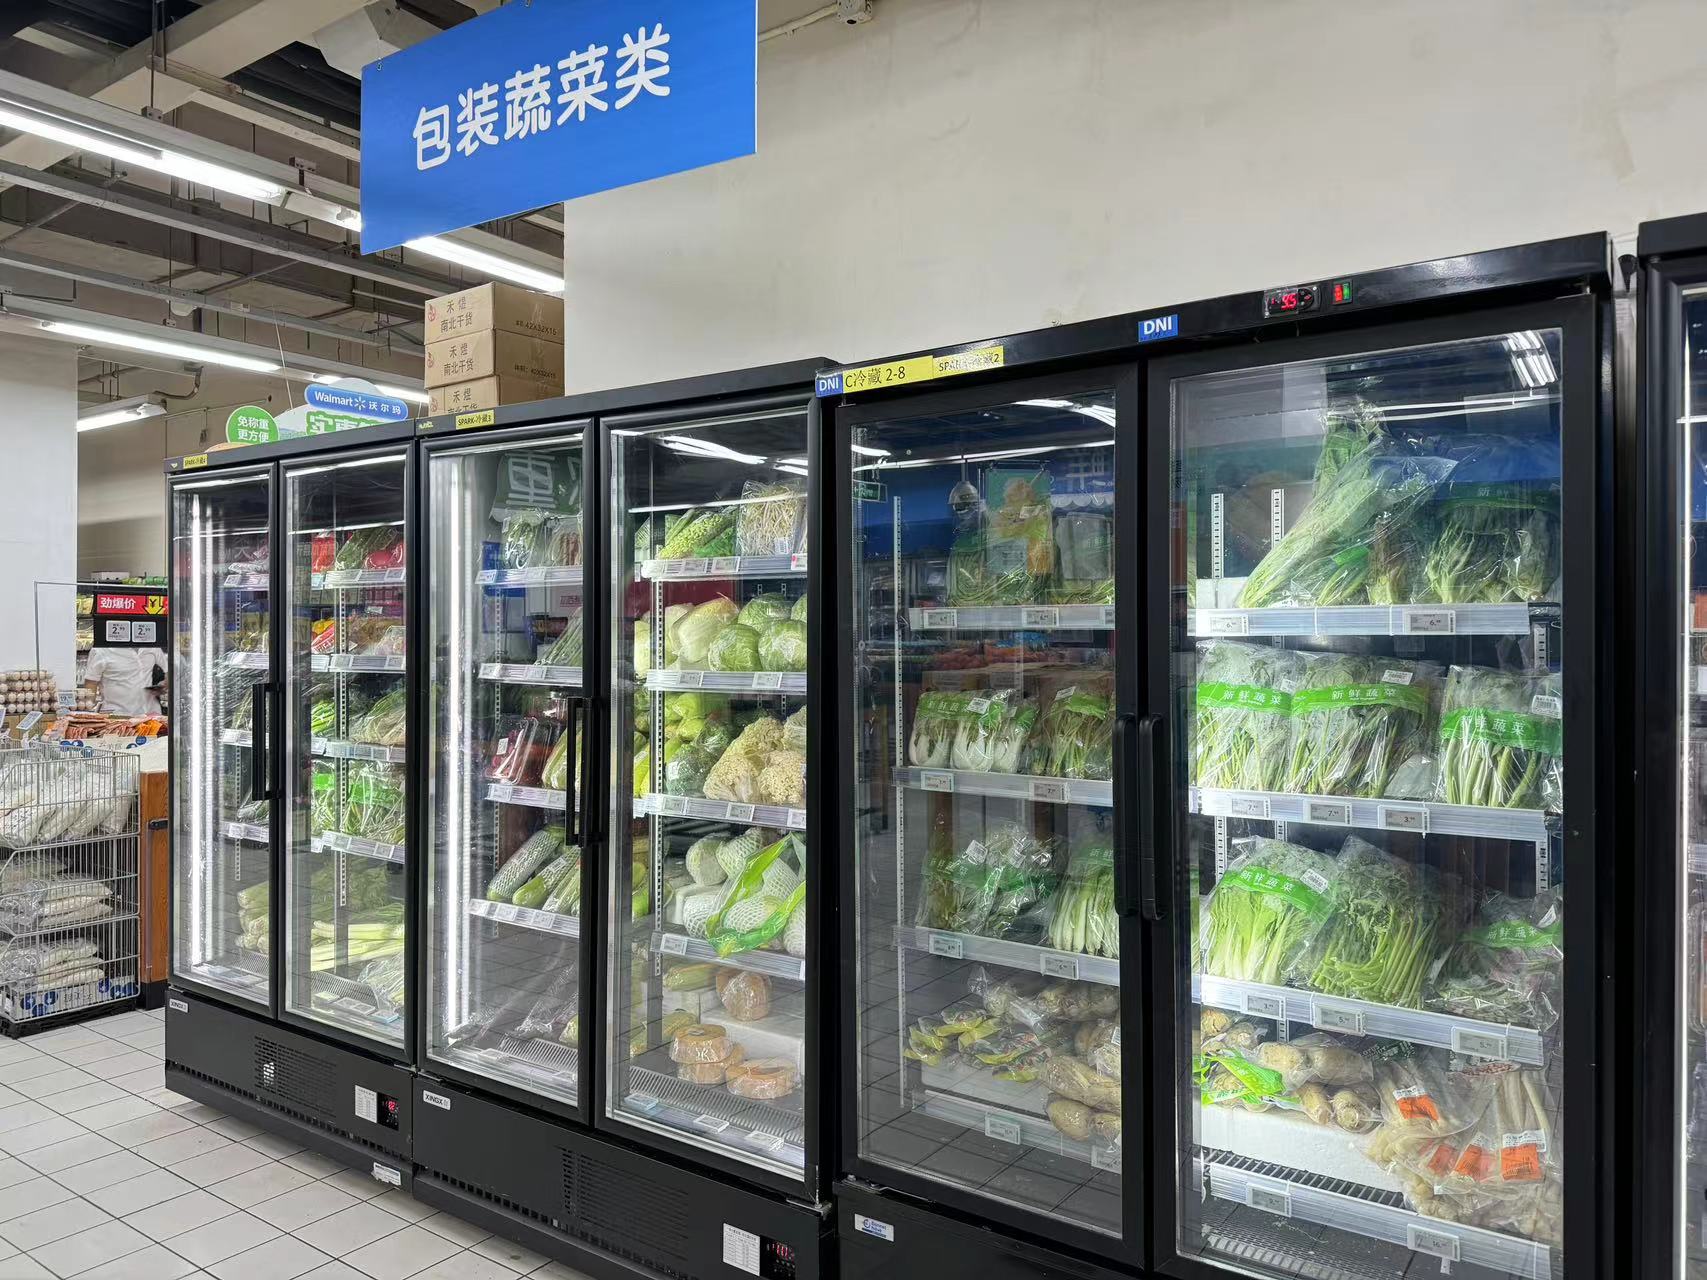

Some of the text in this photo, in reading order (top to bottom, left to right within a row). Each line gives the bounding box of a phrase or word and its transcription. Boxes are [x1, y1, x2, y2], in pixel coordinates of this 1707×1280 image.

[413, 23, 670, 170] 包装蔬菜类
[441, 312, 472, 333] 南北干货
[1143, 316, 1172, 335] DNI
[443, 358, 473, 376] 南北干货
[820, 377, 839, 391] DNI
[845, 366, 906, 388] C冷藏 2-8
[314, 391, 353, 407] Walmart
[369, 401, 401, 415] 沃尔玛
[237, 415, 270, 429] 免称重
[237, 429, 270, 443] 更方便
[100, 597, 136, 609] 劲爆价
